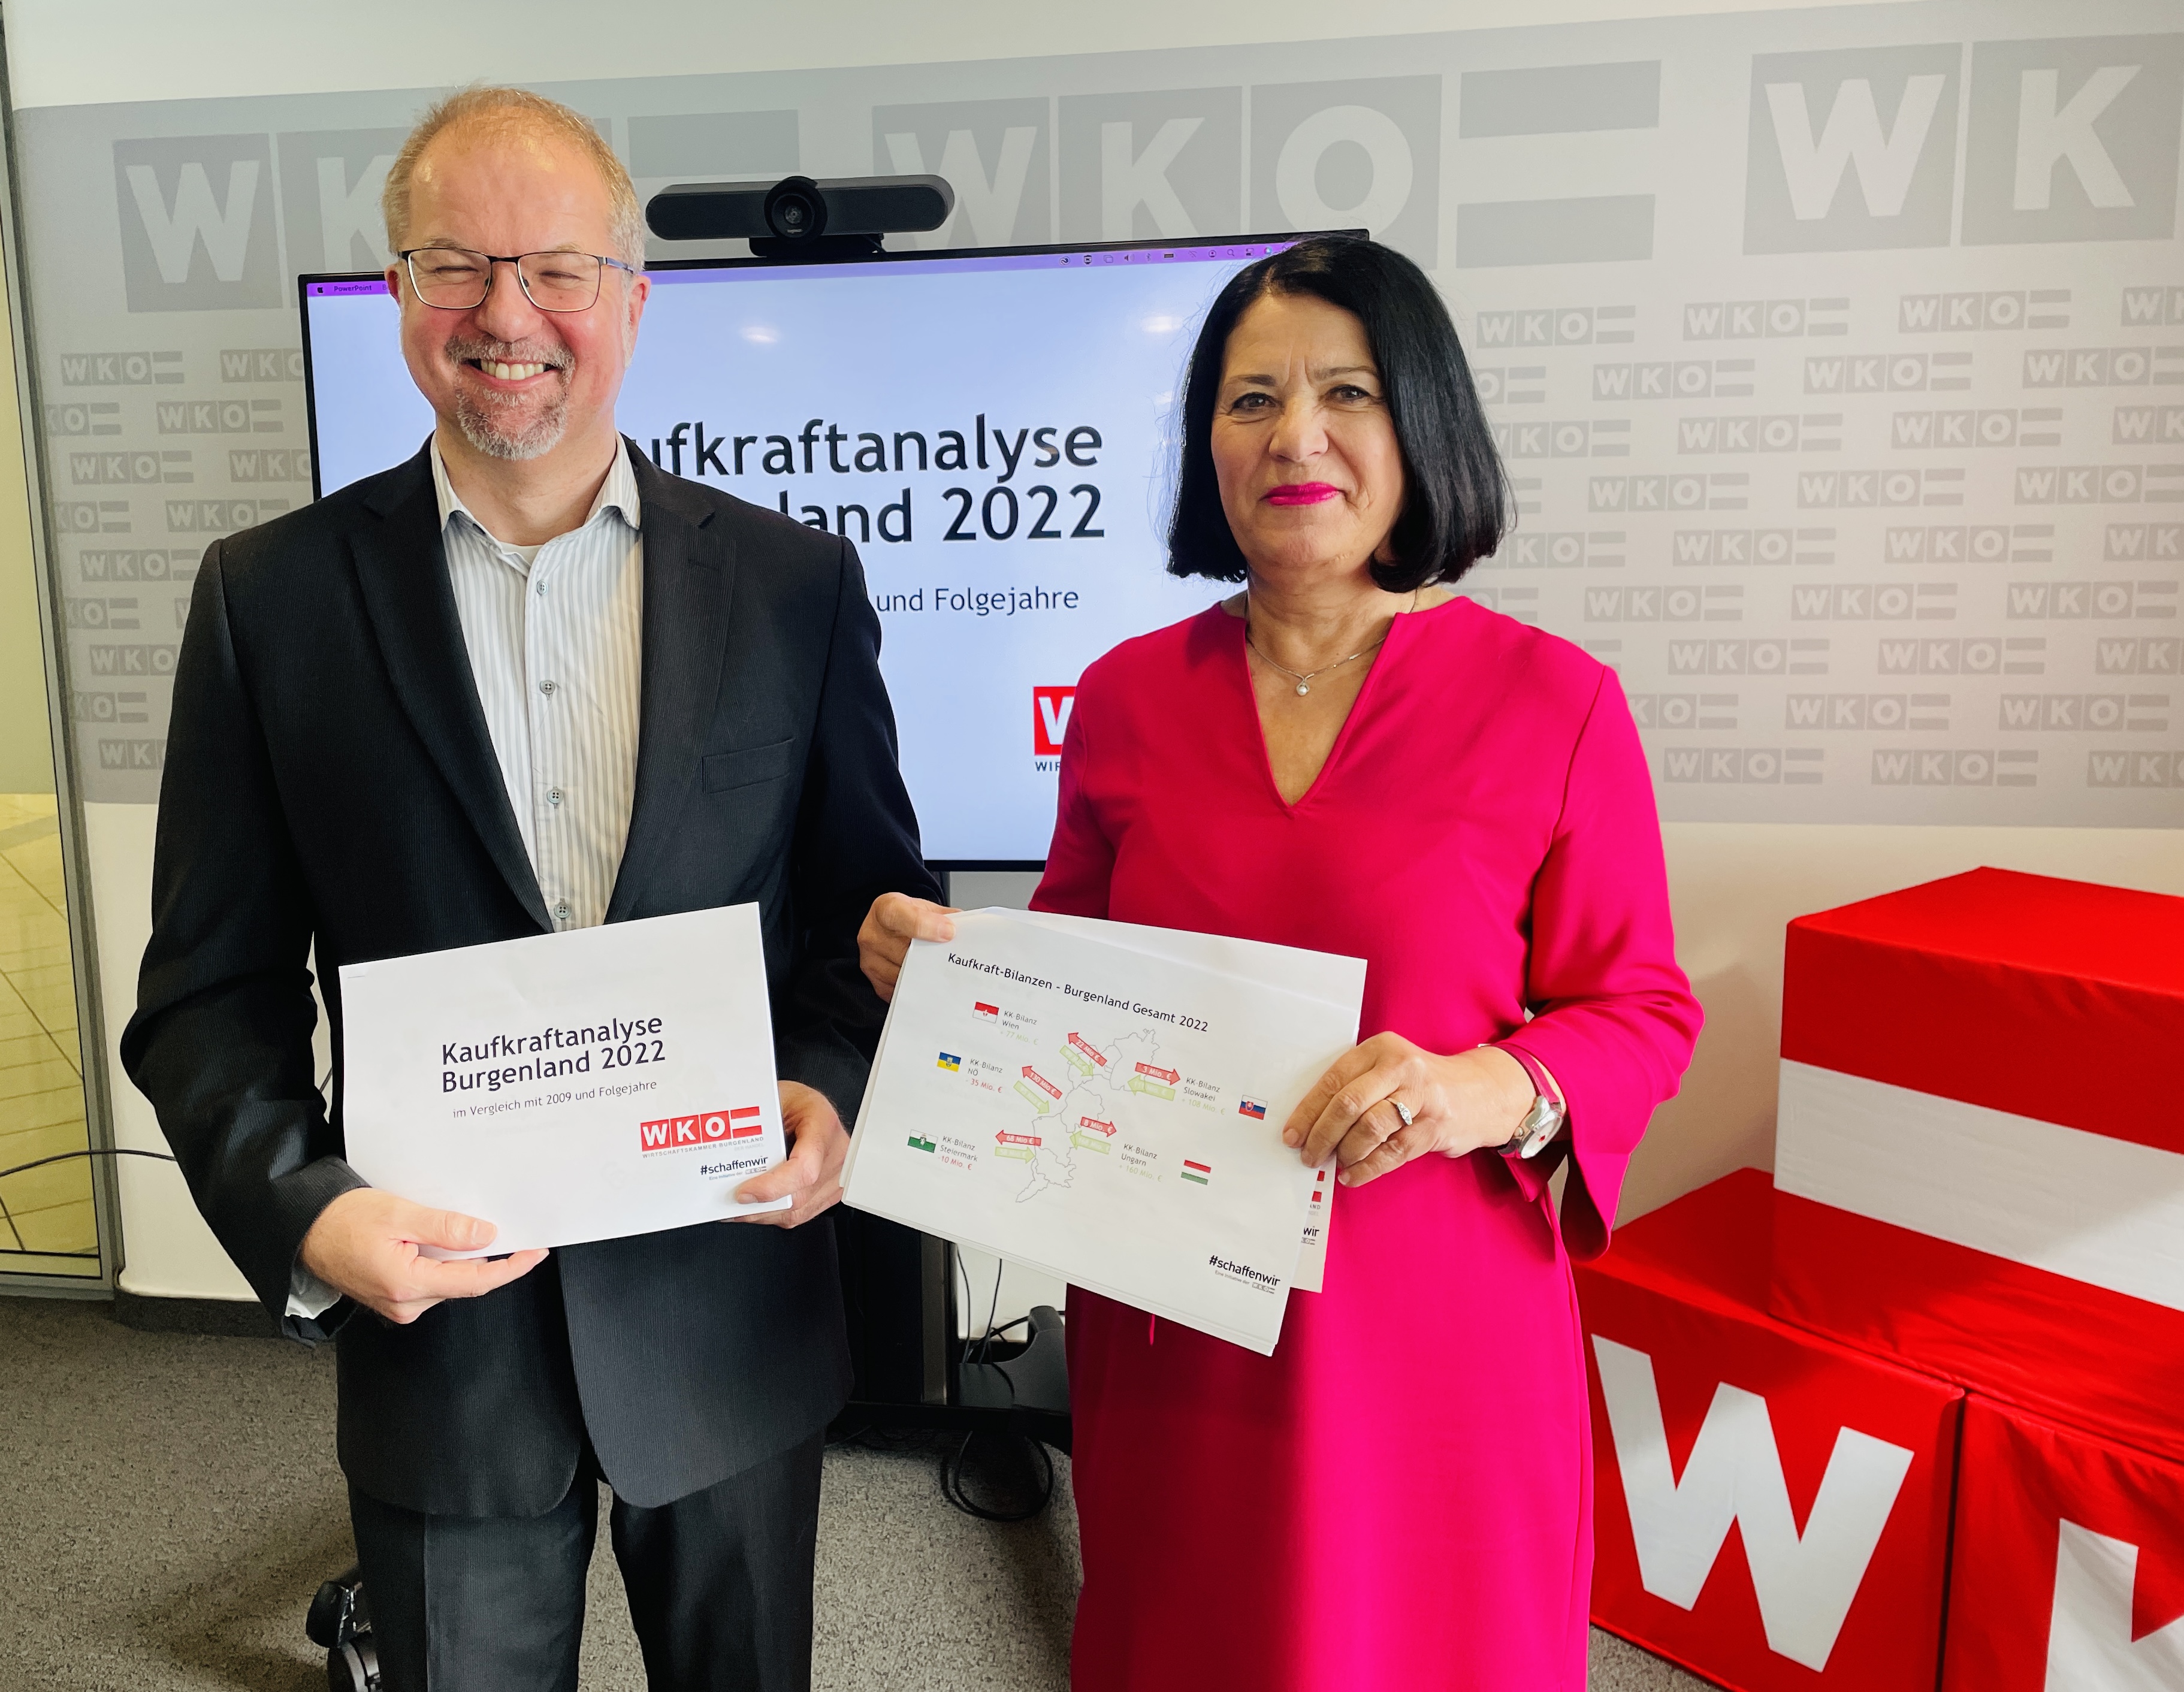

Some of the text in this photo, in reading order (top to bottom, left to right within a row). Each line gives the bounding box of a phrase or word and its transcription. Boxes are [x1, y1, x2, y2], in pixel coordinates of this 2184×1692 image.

[1765, 64, 2143, 220] WK
[125, 155, 394, 283] WK
[2117, 409, 2184, 439] WK
[943, 484, 1105, 542] 2022
[1517, 537, 1579, 563] KO
[2109, 528, 2181, 556] WK
[878, 585, 1079, 616] und Folgejahre
[2101, 642, 2170, 670] WK
[1629, 697, 1691, 724] KO
[101, 744, 165, 766] WK
[2091, 754, 2184, 782] WK
[948, 953, 1052, 990] Kaufkraft-Bilanzen
[1064, 984, 1130, 1011] Burgenland
[1133, 1003, 1176, 1023] Gesamt
[1179, 1015, 1209, 1032] 2022
[1002, 1020, 1019, 1030] Wien
[1004, 1011, 1037, 1025] KK-Bilanz
[442, 1017, 663, 1065] Kaufkraftanalyse
[443, 1040, 666, 1093] Burgenland 2022
[968, 1068, 978, 1076] NÖ
[970, 1058, 1003, 1073] KK-Bilanz
[971, 1078, 979, 1086] 35
[1030, 1072, 1040, 1083] 130
[1186, 1077, 1221, 1093] KK-Bilanz
[453, 1080, 657, 1119] im Vergleich mit 2009 und Folgejahre
[1183, 1087, 1216, 1102] Slowakei
[1189, 1099, 1201, 1108] 108
[642, 1116, 726, 1147] WKO
[642, 1137, 764, 1158] WIRTSCHAFTSKAMMER BURGENLAND
[940, 1145, 978, 1162] Steiermark
[942, 1136, 975, 1151] KK-Bilanz
[1123, 1143, 1158, 1159] KK-Bilanz
[700, 1155, 768, 1175] #schaffenwir
[1121, 1153, 1146, 1167] Ungarn
[1126, 1165, 1138, 1174] 160
[1209, 1255, 1280, 1286] #schaffenwir
